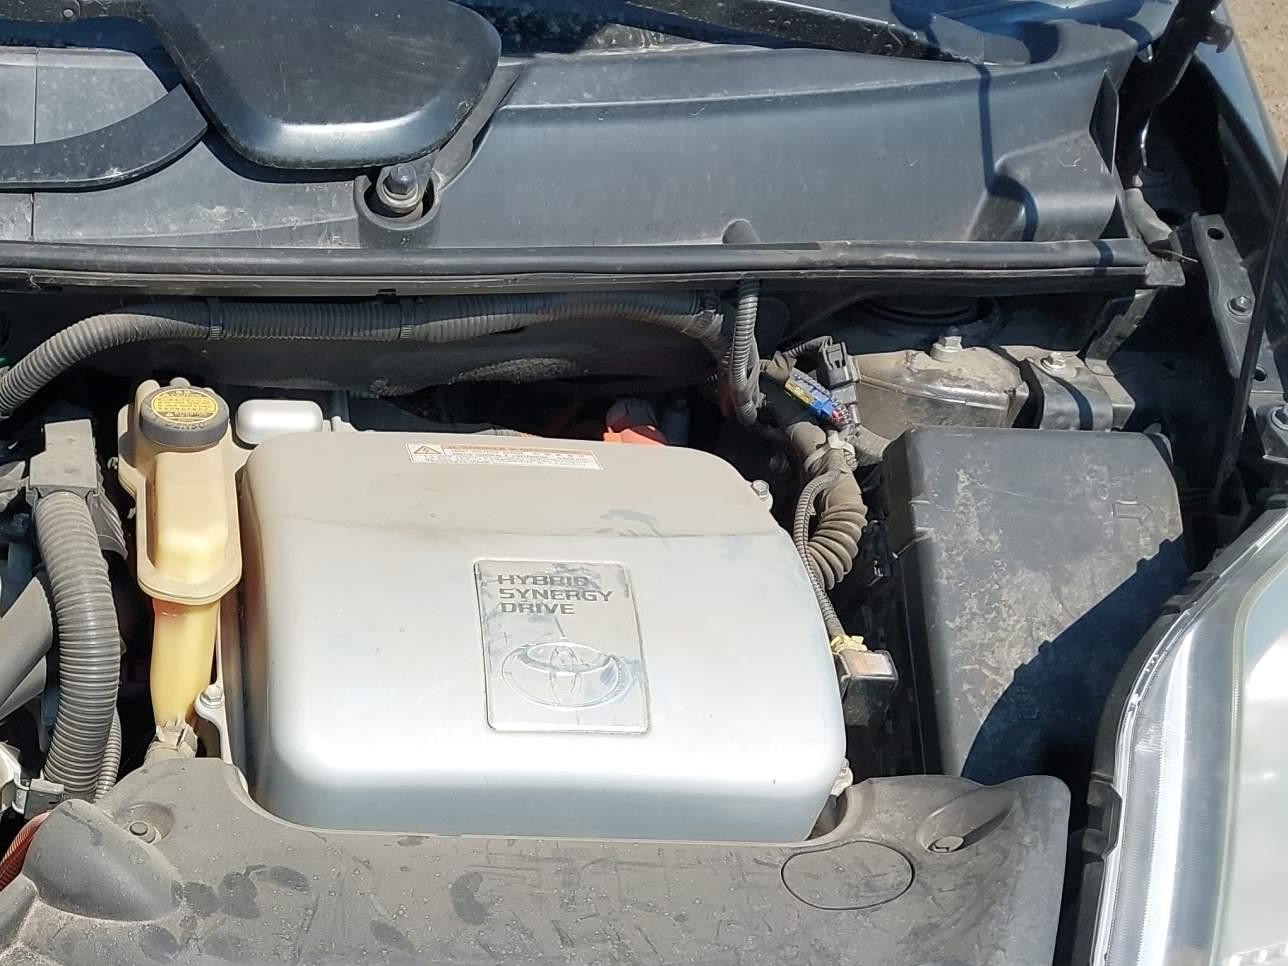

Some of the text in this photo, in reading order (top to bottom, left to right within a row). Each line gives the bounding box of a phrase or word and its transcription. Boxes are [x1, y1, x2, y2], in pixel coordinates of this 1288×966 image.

[497, 574, 593, 588] HYBRID
[499, 588, 614, 602] SYNERGY
[501, 602, 575, 615] DRIVE
